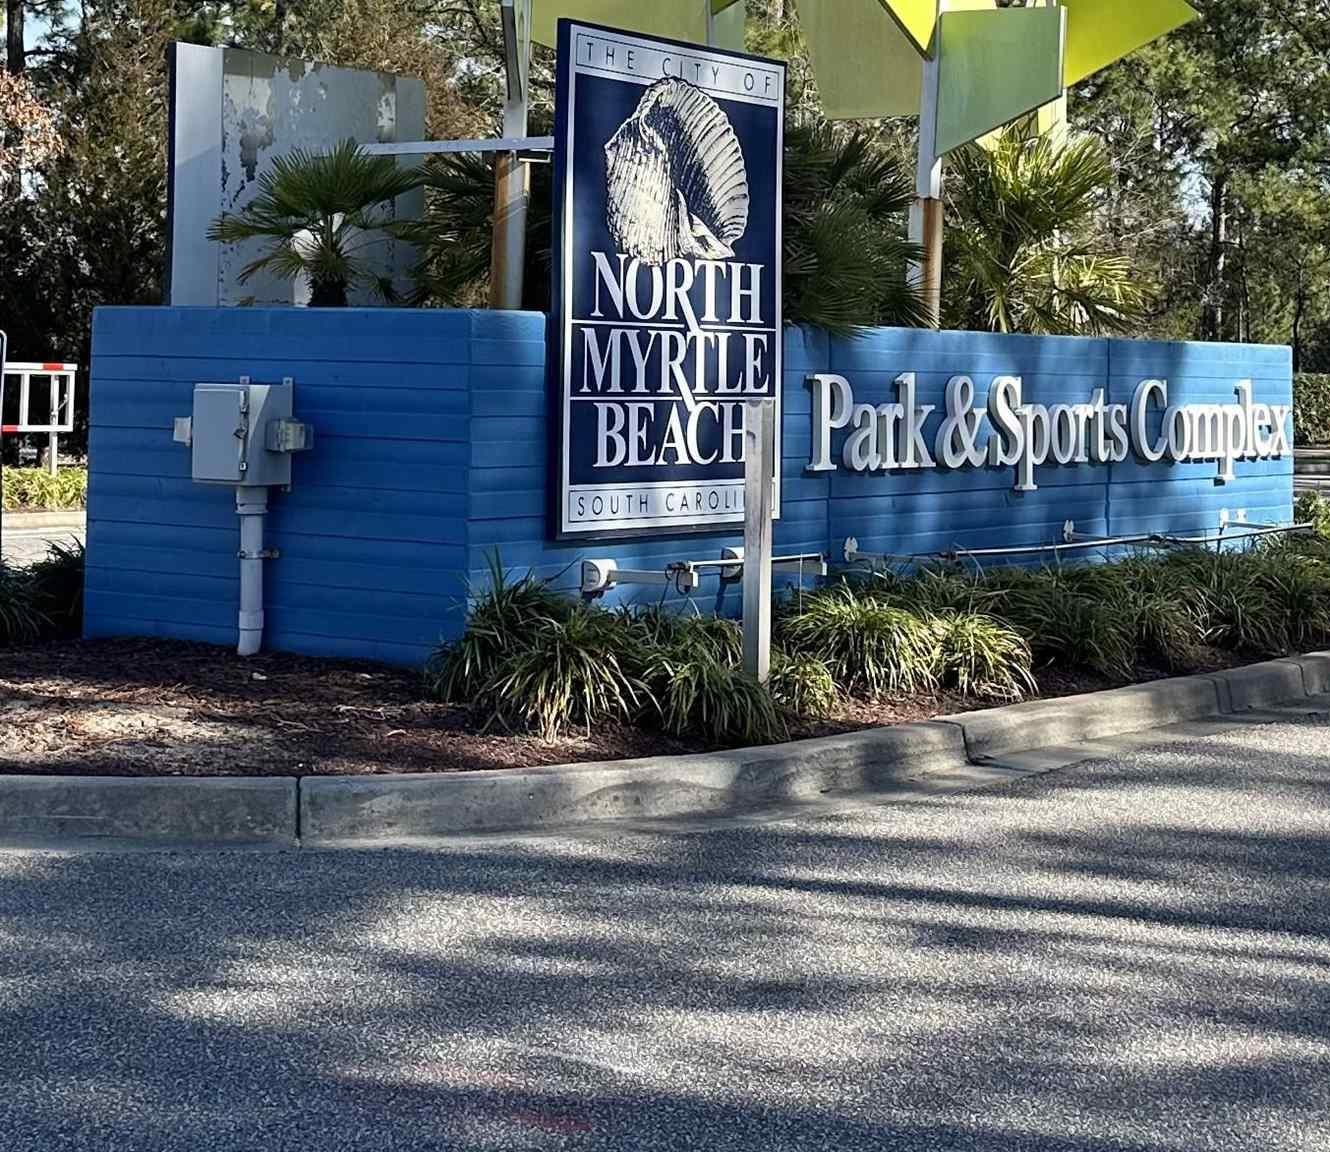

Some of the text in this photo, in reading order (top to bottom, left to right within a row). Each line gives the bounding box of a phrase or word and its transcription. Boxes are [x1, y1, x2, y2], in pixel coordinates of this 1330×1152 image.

[586, 42, 772, 94] THE CITY OF
[590, 251, 765, 324] NORTH
[579, 327, 769, 394] MYRTLE
[592, 401, 746, 468] BEACH
[805, 373, 1290, 491] Park & Sports Complex
[577, 494, 649, 516] SOUTH
